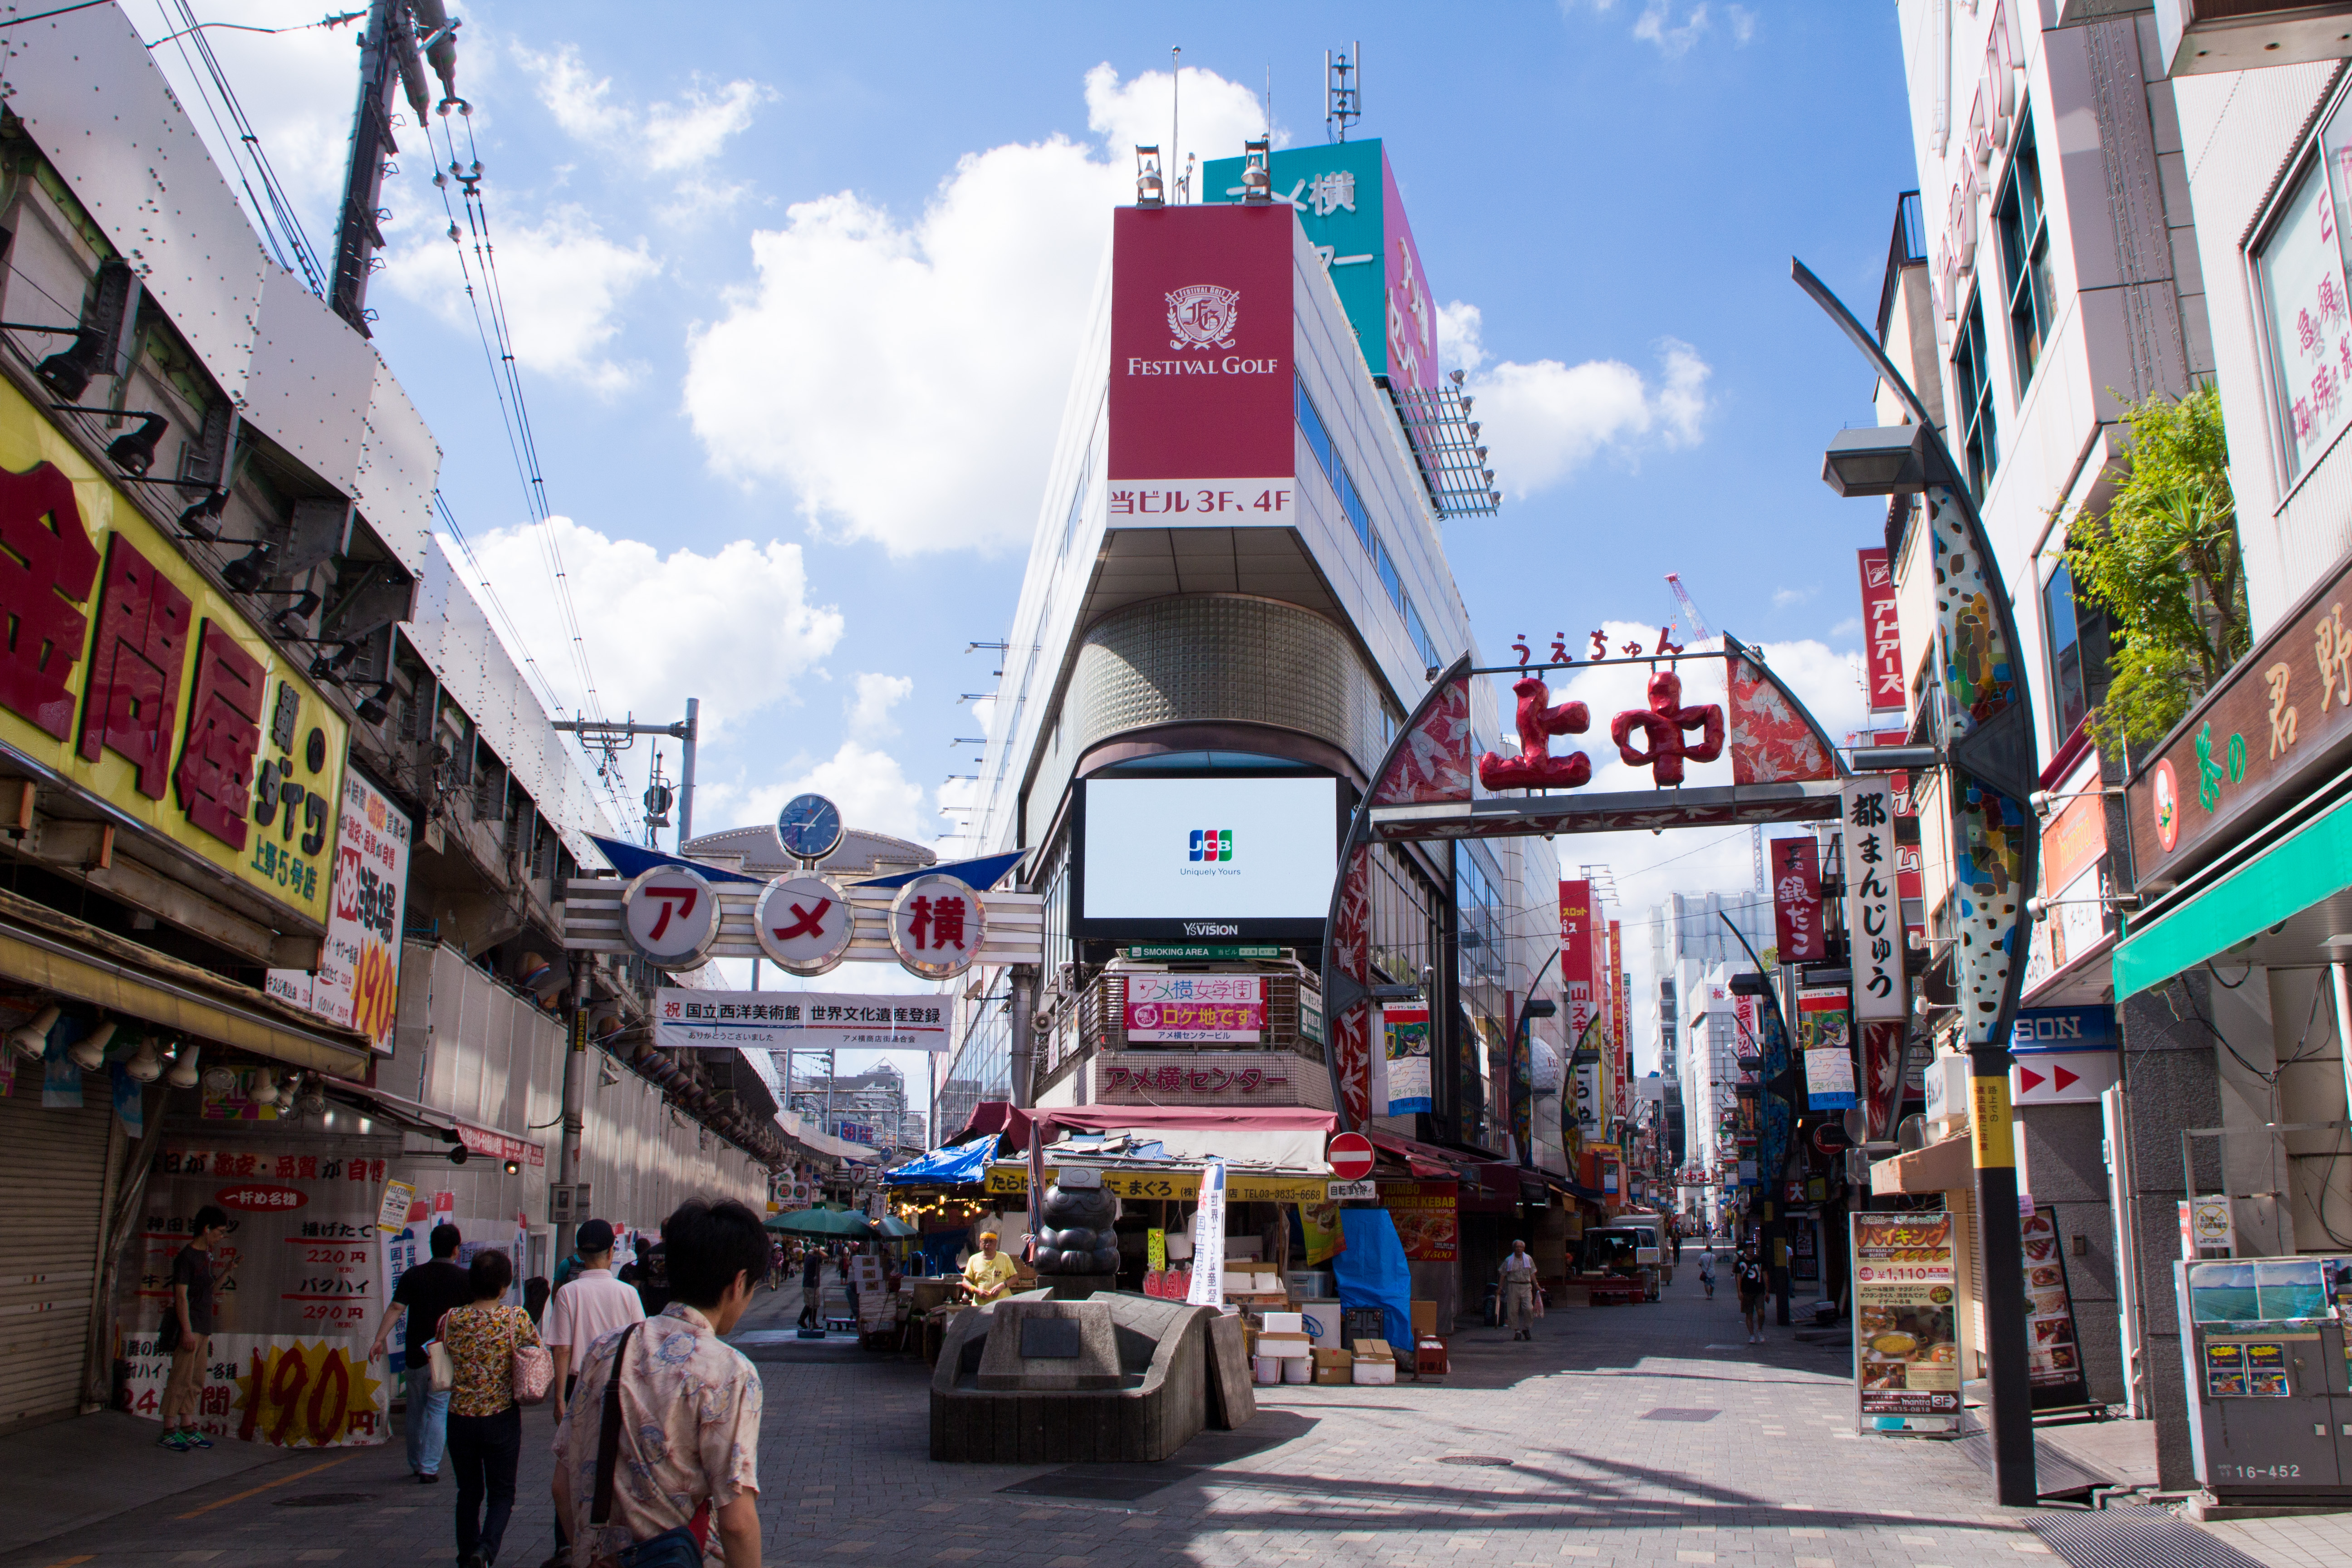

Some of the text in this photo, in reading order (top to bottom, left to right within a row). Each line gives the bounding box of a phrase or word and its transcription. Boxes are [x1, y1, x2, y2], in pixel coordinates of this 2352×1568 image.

[1180, 287, 1225, 298] FESTIVAL GOLF
[2296, 271, 2336, 358] 急須
[1127, 356, 1278, 376] FESTIVAL GOLF
[1110, 490, 1190, 514] 当ビル
[1511, 627, 1684, 666] うえちゅん
[1872, 599, 1904, 694] アドアーズ
[1479, 671, 1724, 791] 上中
[2195, 720, 2247, 814] 茶の
[1189, 840, 1231, 852] JCB
[250, 833, 318, 902] 上野5号店
[1180, 867, 1241, 876] Uniquely Yours
[334, 848, 396, 944] め酒場
[1850, 791, 1893, 999] 都まんじゅう
[645, 887, 965, 950] アメ横
[1563, 906, 1588, 916] スロット
[1777, 875, 1818, 956] 銀だこ
[1196, 925, 1238, 935] VISION
[1143, 948, 1209, 956] SMOKING AREA
[1138, 980, 1251, 1000] アメ横女学園
[1612, 931, 1623, 1044] パチンコ&スロット
[665, 1002, 941, 1023] 祝 国立西洋美術館 世界文化遺産登録
[1163, 1007, 1252, 1025] ロケ地です
[688, 1031, 916, 1044] ありがとうございました アメ横商店街連合会
[1157, 1031, 1230, 1040] アメ横センタービル
[1105, 1066, 1288, 1092] アメ横センター
[1988, 1086, 1999, 1122] 路上での
[1129, 1179, 1173, 1196] まぐろ
[1384, 1183, 1421, 1195] JUMBO
[224, 1190, 298, 1208] 一軒め名物
[1384, 1196, 1456, 1208] DONER KEBAB
[302, 1221, 373, 1238] 揚げたて
[1857, 1220, 1949, 1247] バイキング
[306, 1249, 367, 1264] 220円
[1877, 1268, 1926, 1281] ¥1,110
[303, 1305, 364, 1320] 290円
[1901, 1397, 1931, 1407] mantra
[1934, 1396, 1950, 1406] 3F
[2236, 1465, 2301, 1479] 16-452
